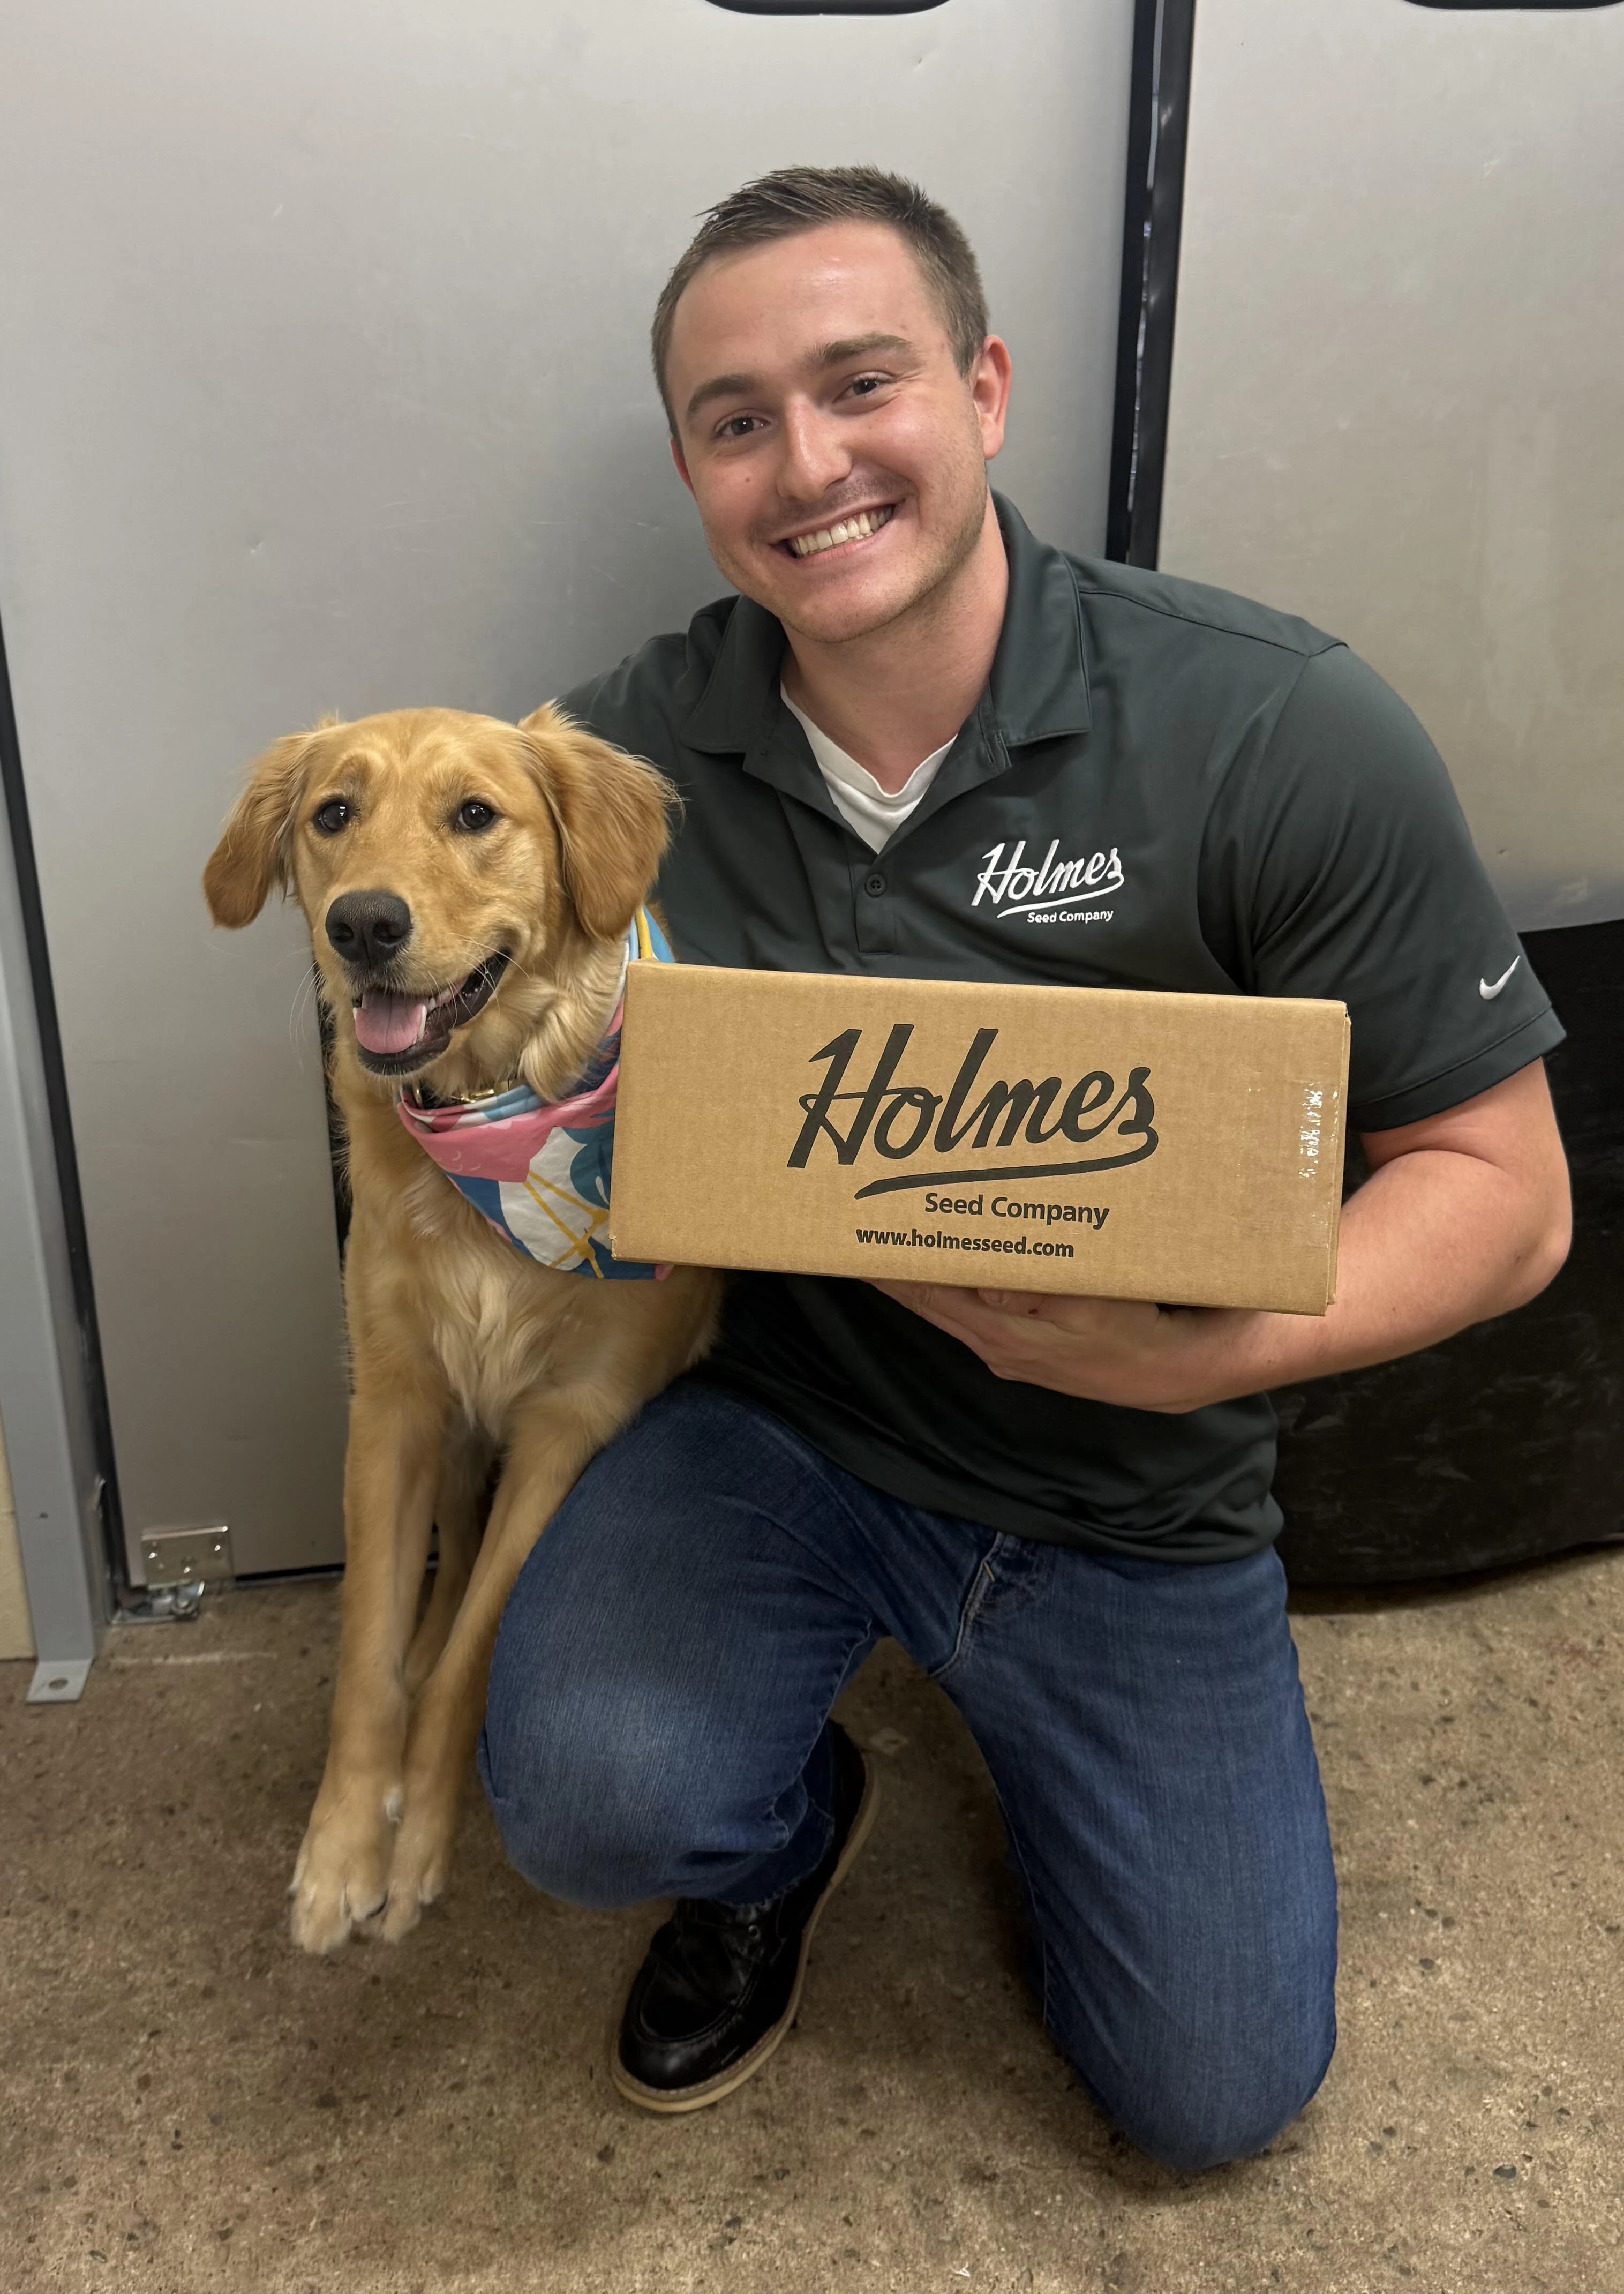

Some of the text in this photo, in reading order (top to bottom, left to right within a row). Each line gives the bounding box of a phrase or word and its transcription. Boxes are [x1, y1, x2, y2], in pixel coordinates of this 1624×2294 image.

[971, 838, 1124, 906] Holmes
[1027, 910, 1114, 924] Seed Company
[786, 1023, 1159, 1170] Holmes
[924, 1192, 1110, 1231] Seed Company
[856, 1228, 1074, 1258] www.holmesseed.com
